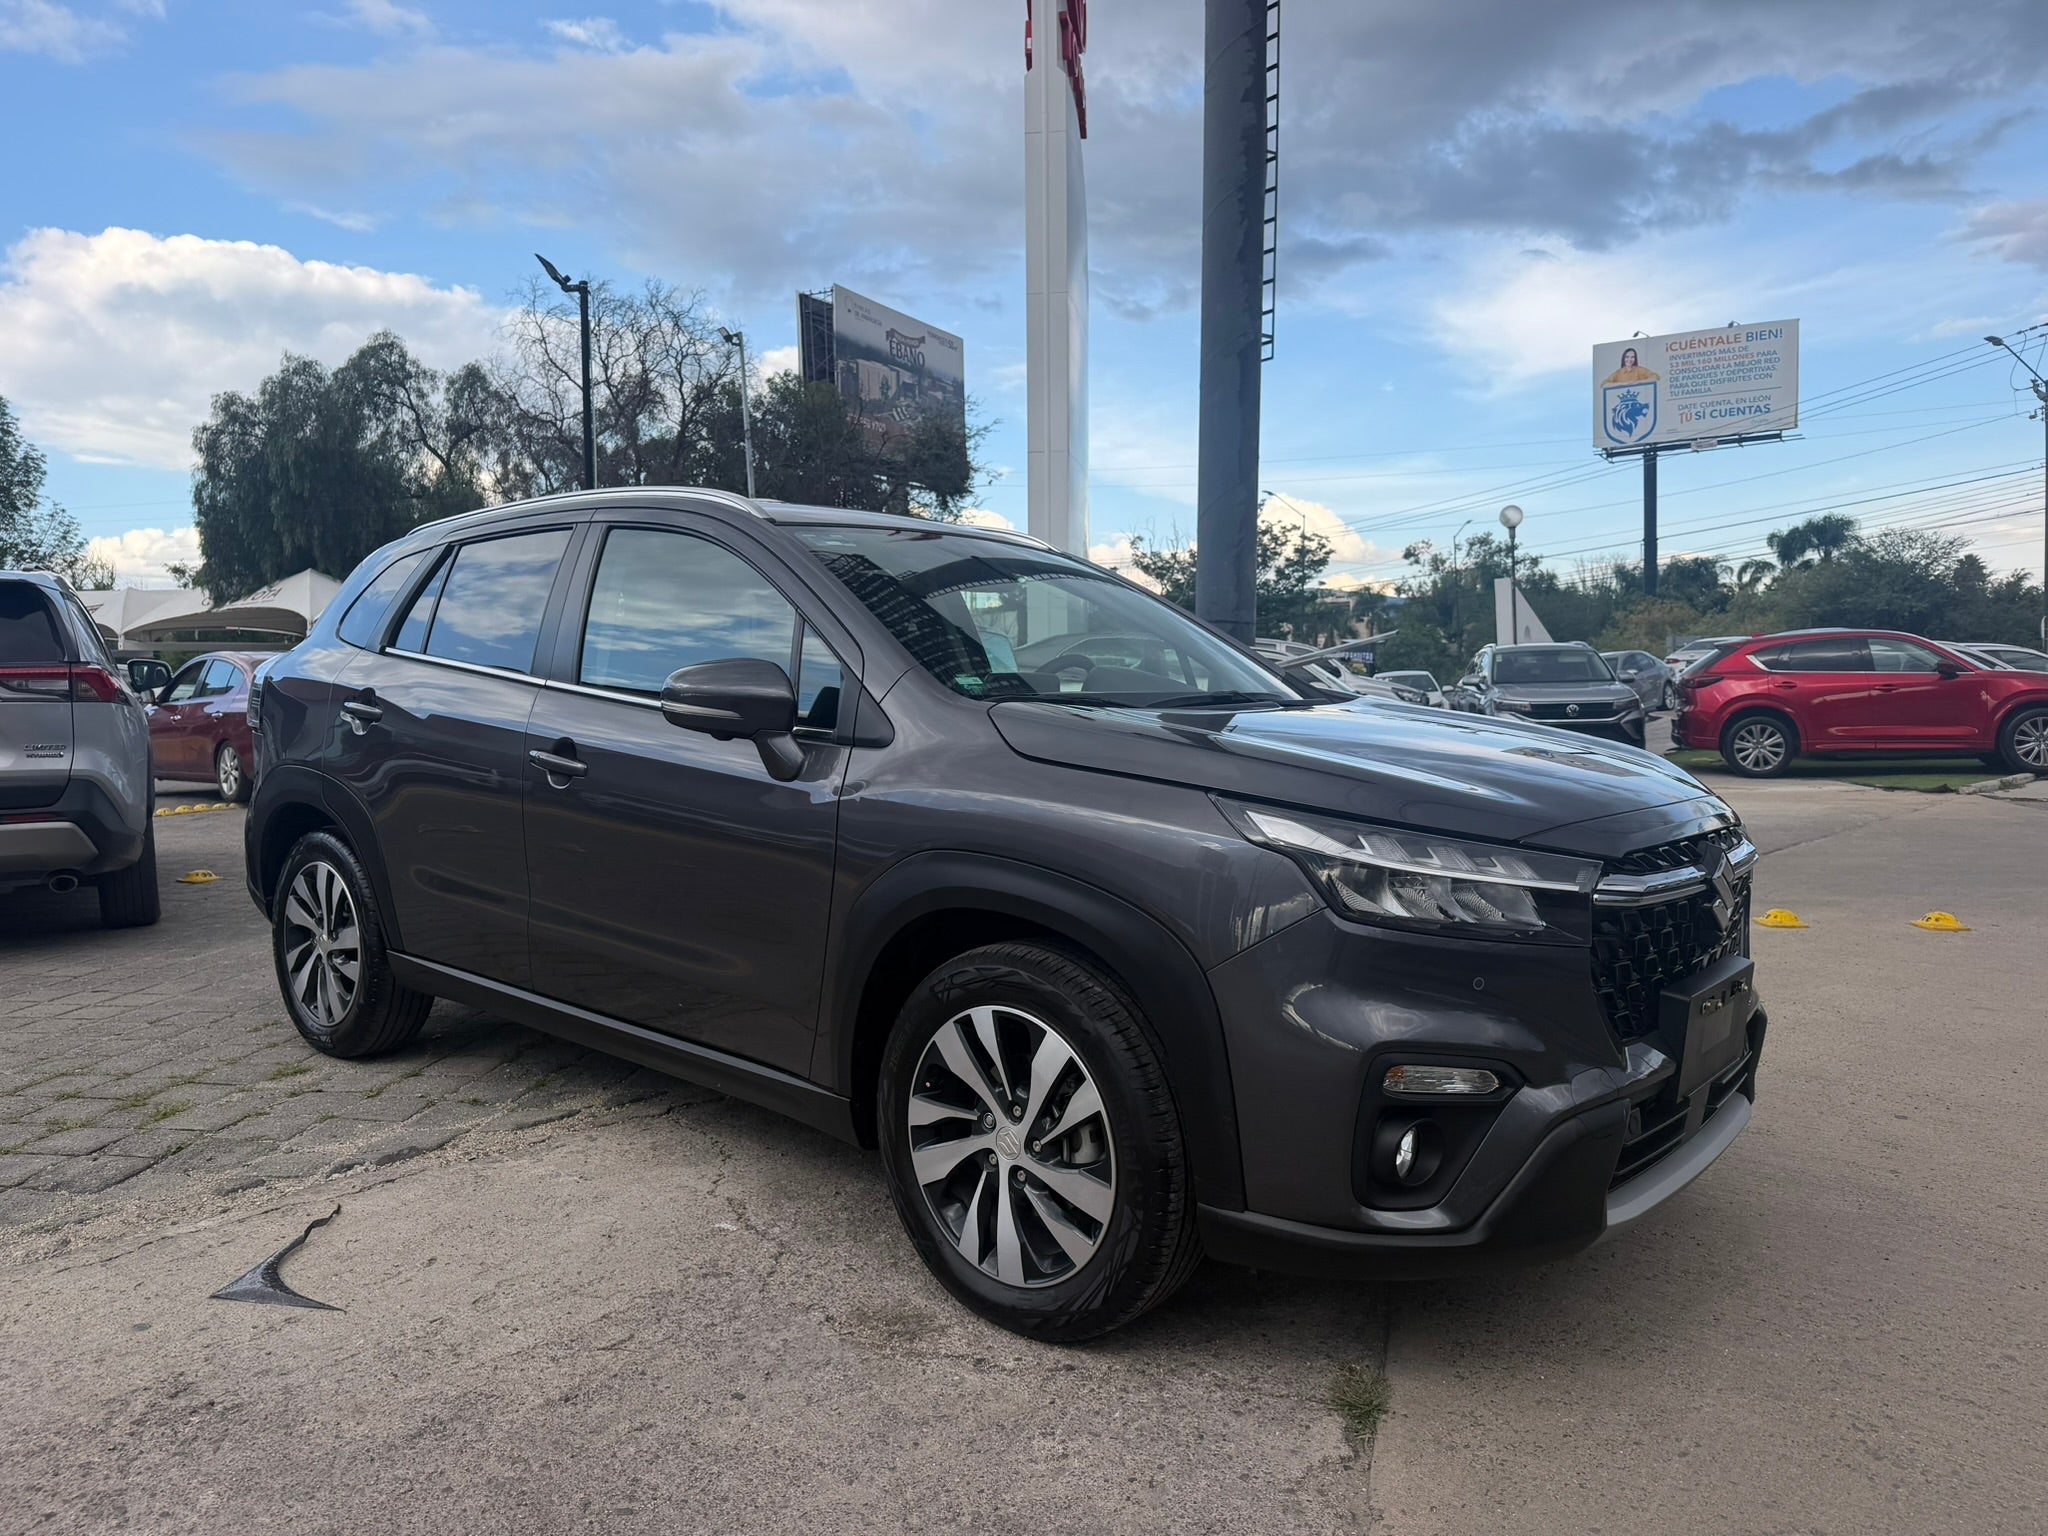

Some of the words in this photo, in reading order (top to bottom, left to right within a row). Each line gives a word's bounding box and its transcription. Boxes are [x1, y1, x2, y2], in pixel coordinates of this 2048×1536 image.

[1665, 334, 1742, 352] ¡CUÉNTALE
[1746, 328, 1783, 342] BIEN!
[1669, 348, 1717, 361] INVERTIMOS
[1718, 346, 1736, 355] MÁS
[1681, 359, 1696, 367] MIL
[1714, 354, 1754, 363] MILLONES
[1756, 350, 1778, 358] PARA
[1669, 363, 1721, 375] CONSOLIDAR
[1733, 358, 1762, 367] MEJOR
[1669, 382, 1689, 390] PARA
[1691, 379, 1707, 388] QUE
[1710, 374, 1752, 385] DISFRUTES
[1682, 372, 1718, 381] PARQUES
[1681, 387, 1712, 396] FAMILIA
[1678, 402, 1698, 411] DATE
[1749, 394, 1771, 403] LEÓN
[1710, 403, 1771, 418] CUENTAS
